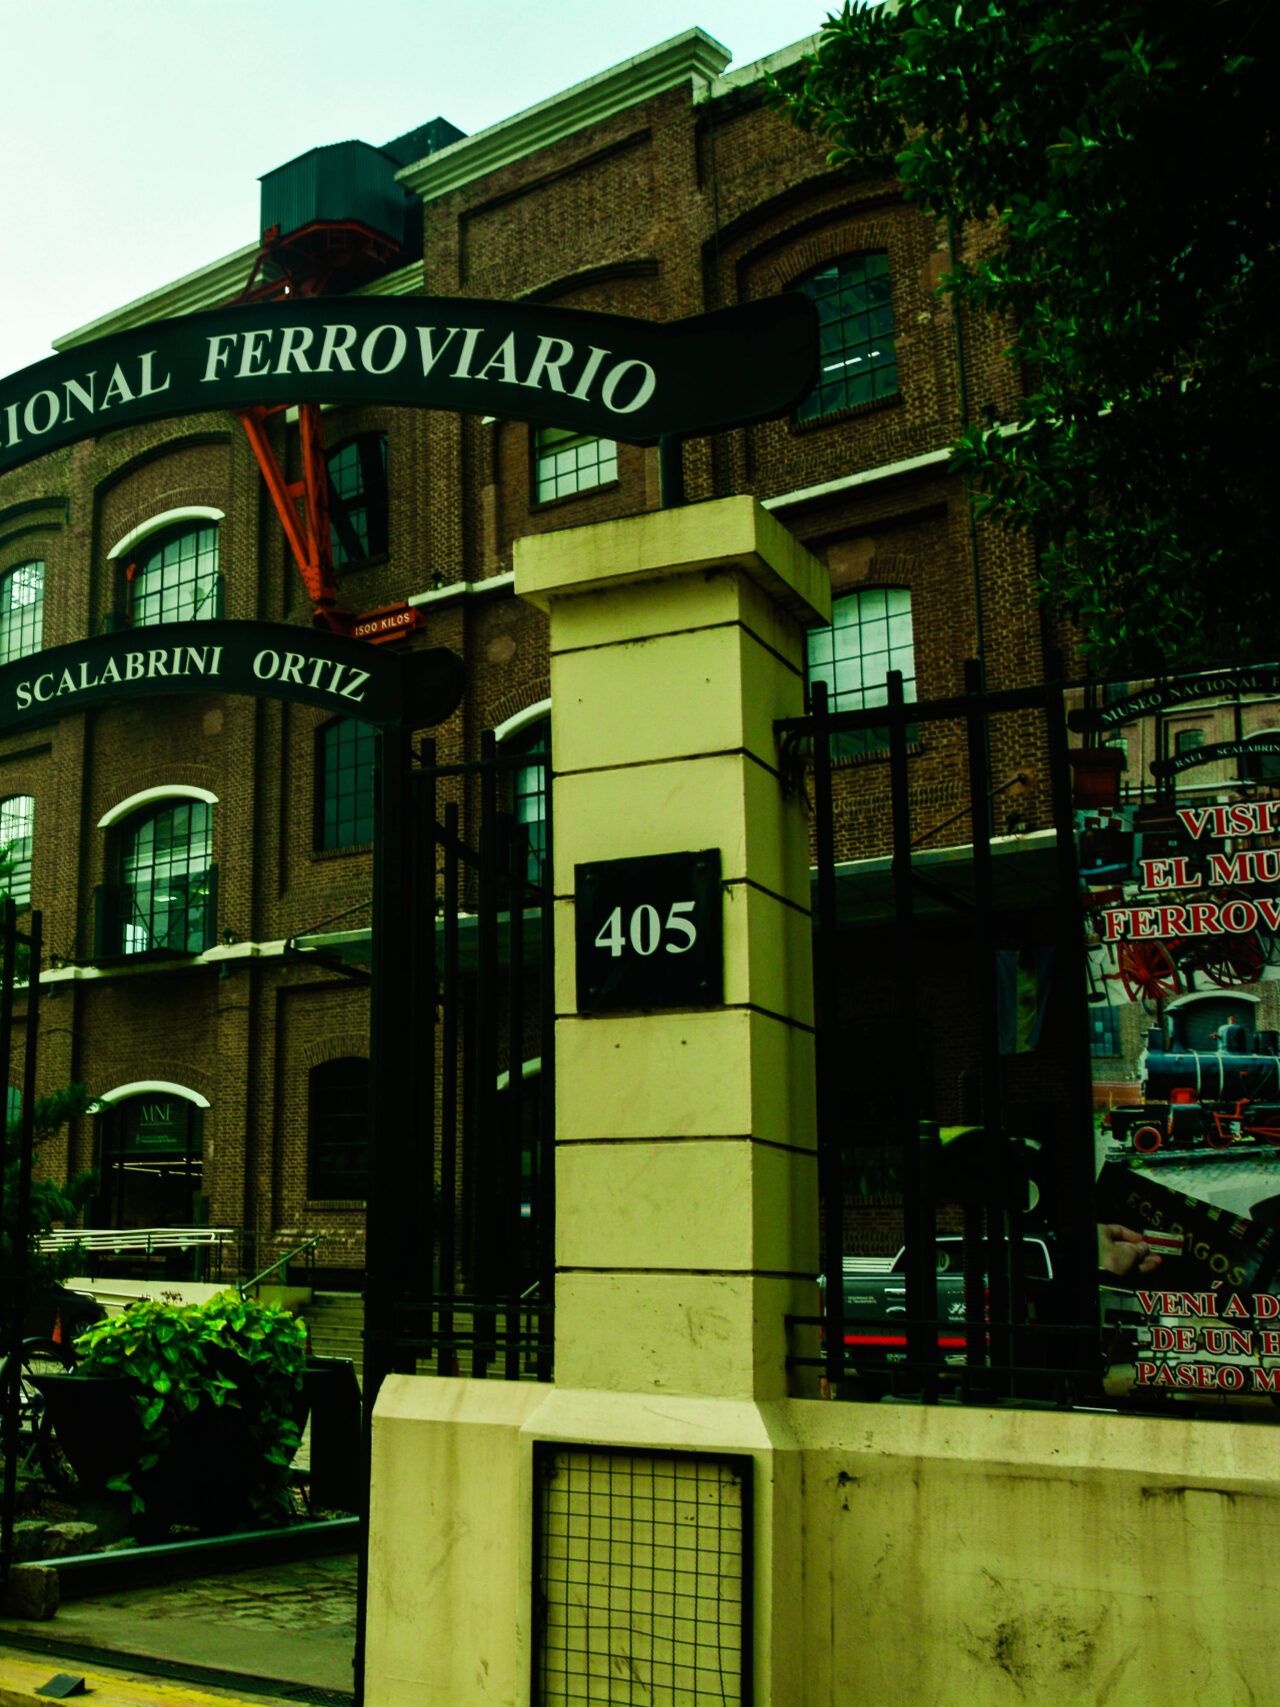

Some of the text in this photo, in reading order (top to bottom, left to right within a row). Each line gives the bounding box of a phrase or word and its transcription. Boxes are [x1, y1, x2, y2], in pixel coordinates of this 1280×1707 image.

[200, 324, 657, 415] FERROVIARIO
[355, 612, 410, 636] 1500 KILOS
[16, 646, 224, 711] SCALABRINI
[253, 649, 372, 702] ORTIZ
[1100, 692, 1163, 725] MUSEO
[1176, 800, 1280, 839] VISI
[1139, 857, 1202, 891] EL
[594, 901, 697, 957] 405
[1136, 1281, 1222, 1318] VENÍ
[1222, 1293, 1250, 1318] A
[1150, 1327, 1197, 1353] DE
[1202, 1329, 1253, 1355] UN
[1136, 1361, 1245, 1390] PASEO
